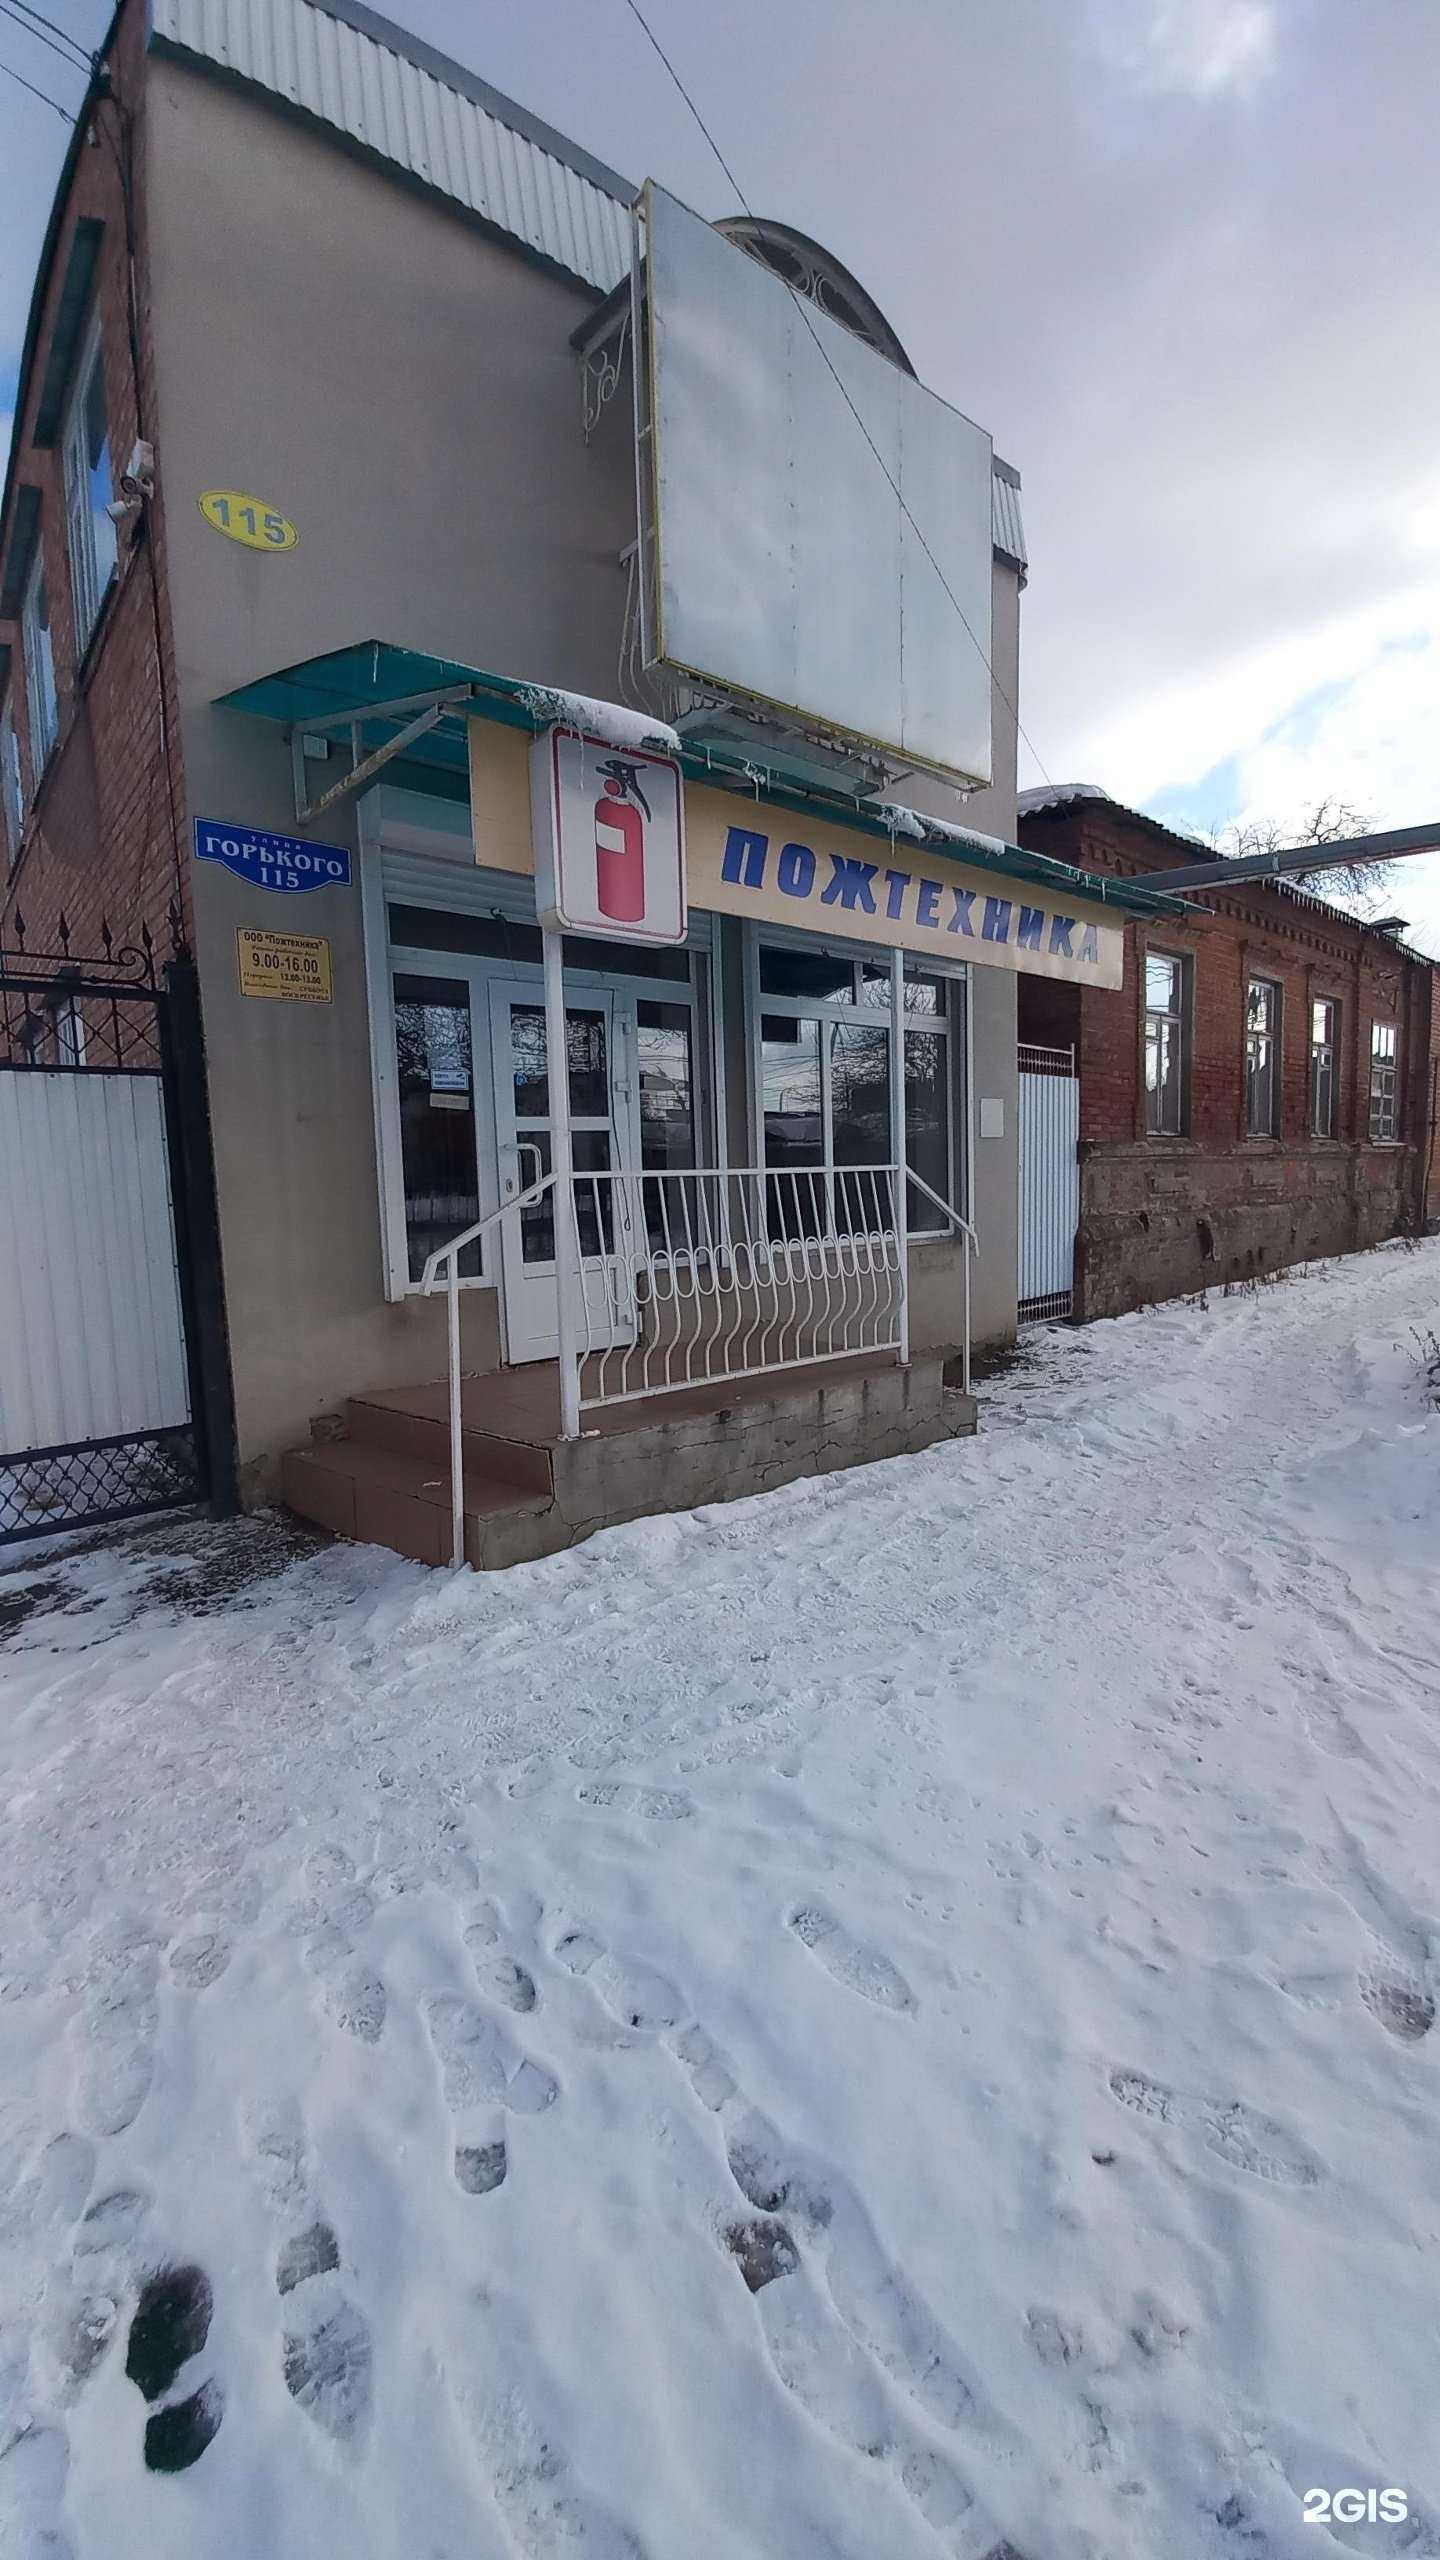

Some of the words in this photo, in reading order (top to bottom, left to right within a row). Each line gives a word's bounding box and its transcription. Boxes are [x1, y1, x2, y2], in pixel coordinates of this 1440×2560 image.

[212, 498, 286, 544] 115
[205, 836, 344, 876] ГОРЬКОГО
[260, 867, 300, 888] 115
[721, 826, 1099, 964] ПОЖТЕХНИКА
[243, 931, 264, 943] ООО
[252, 952, 319, 974] 9.00-16.00
